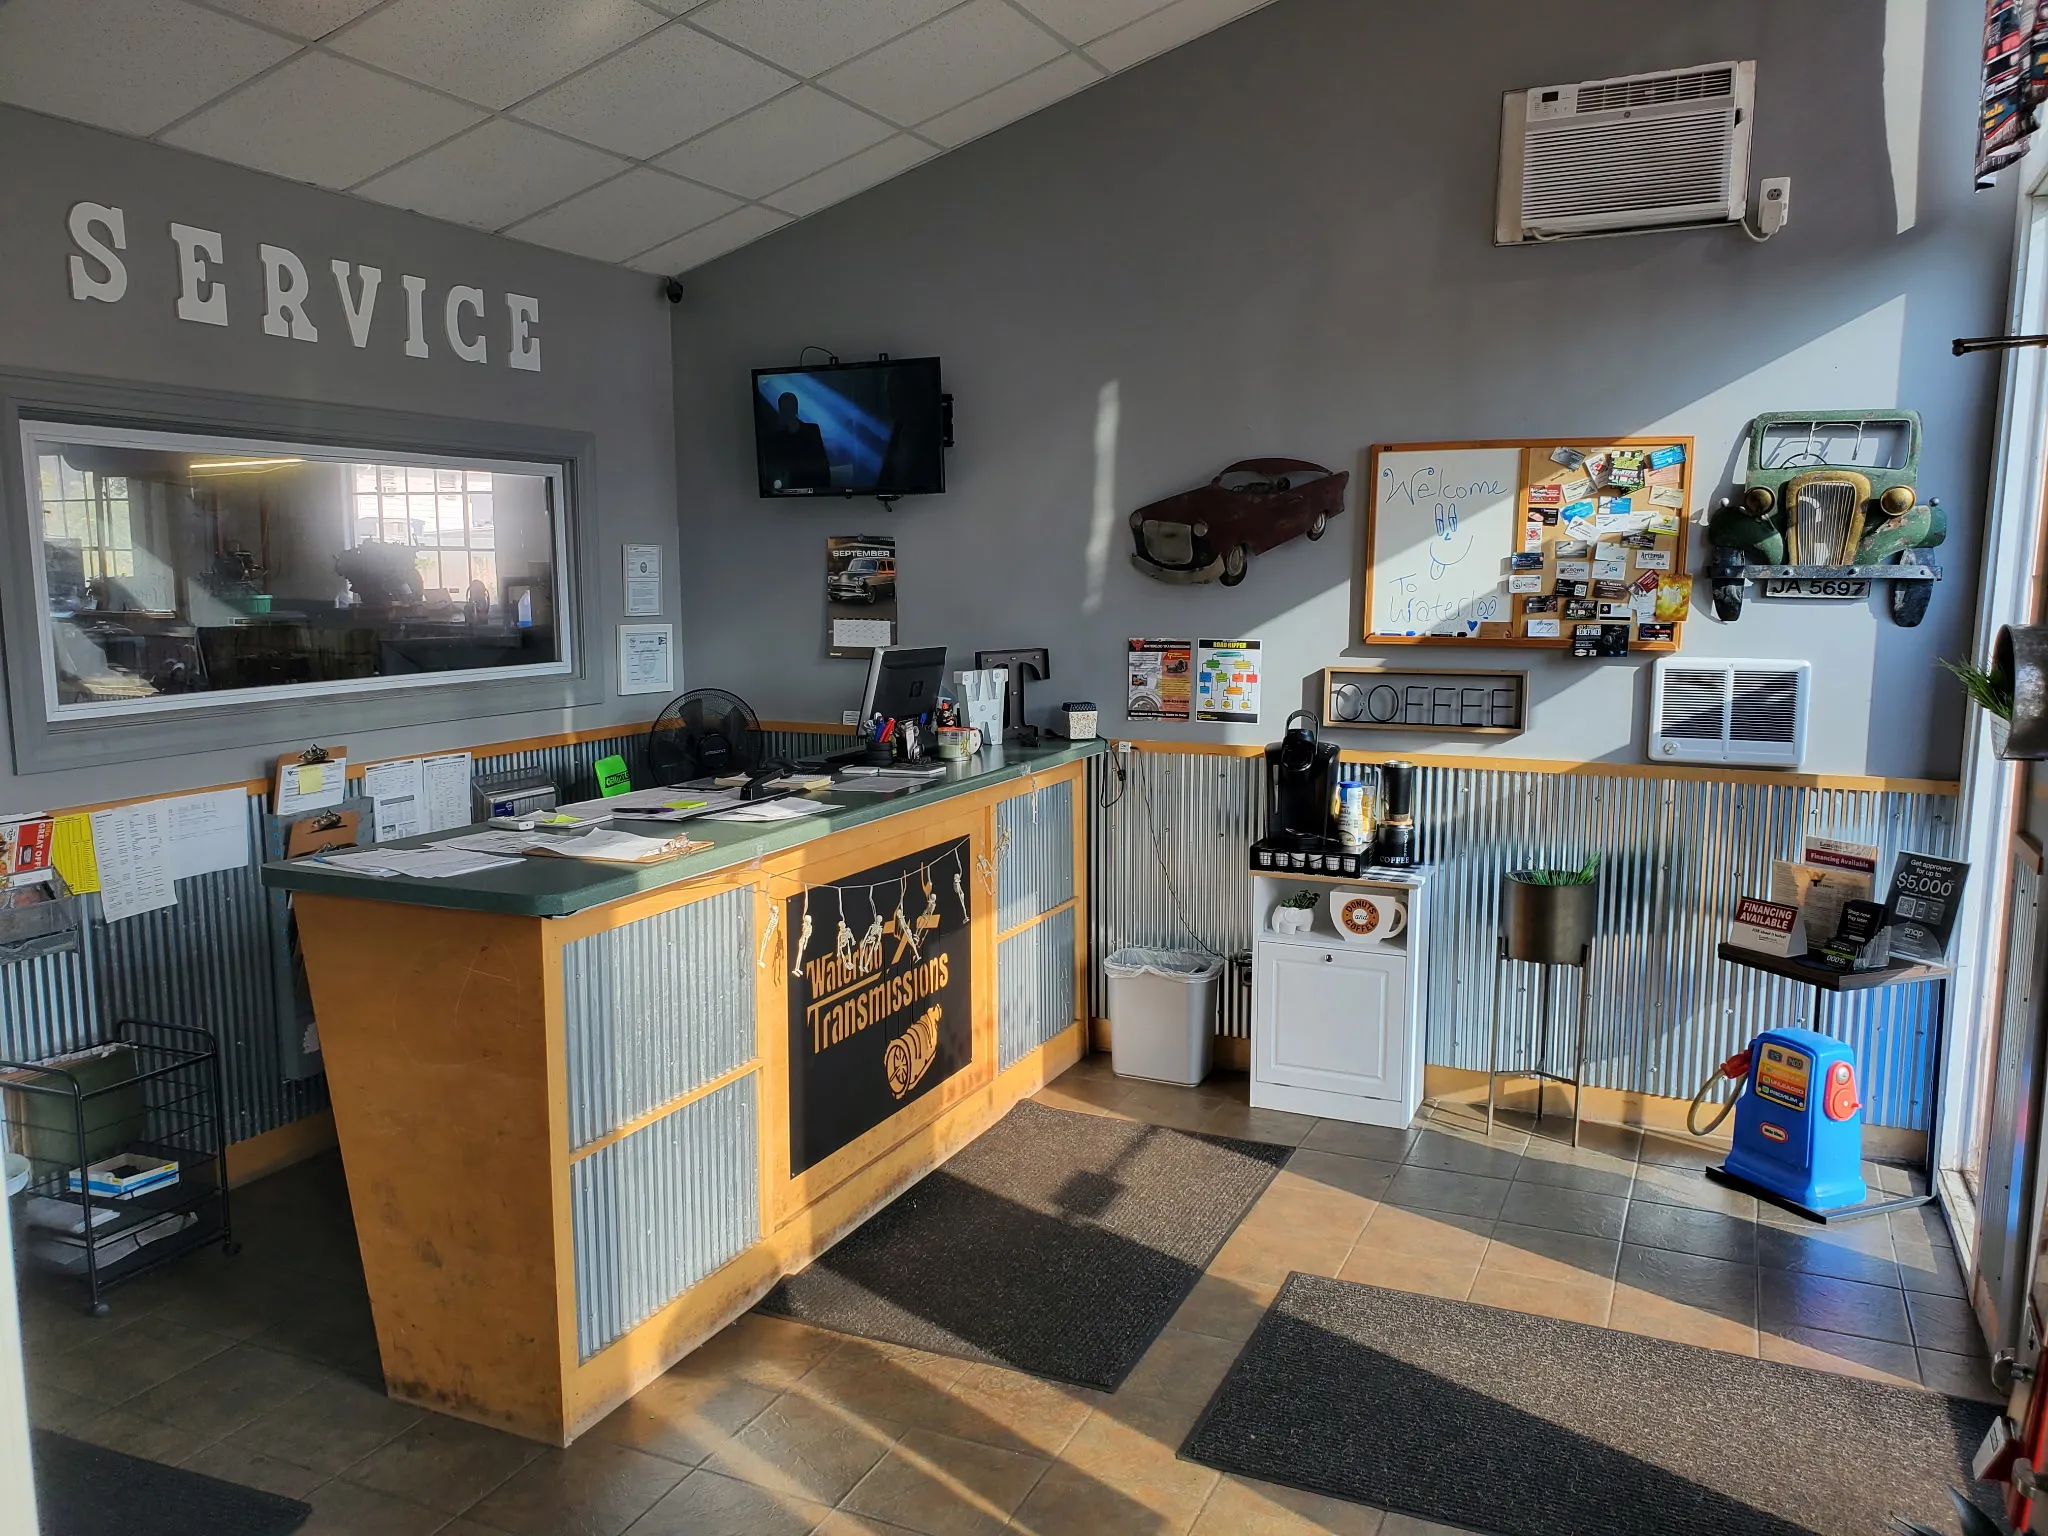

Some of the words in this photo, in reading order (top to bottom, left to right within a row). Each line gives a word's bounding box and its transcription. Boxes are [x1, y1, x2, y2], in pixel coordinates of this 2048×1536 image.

[66, 200, 542, 373] SERVICE
[1383, 467, 1508, 506] Welcome
[1389, 573, 1418, 594] To
[1772, 579, 1802, 594] JA
[1809, 580, 1866, 597] 5697
[1388, 590, 1498, 624] Waterloo
[1335, 683, 1515, 726] COFFEE
[36, 822, 45, 849] GREAT
[1379, 856, 1410, 864] COFFEE
[1810, 852, 1840, 865] Financing
[1840, 857, 1869, 869] Available
[1910, 859, 1922, 867] Get
[1922, 861, 1952, 873] approved
[1925, 870, 1934, 878] up
[1896, 871, 1953, 897] $5,000
[1345, 900, 1377, 915] DONUTS
[1354, 912, 1369, 921] and
[1743, 902, 1793, 920] FINANCING
[1345, 918, 1377, 932] COFFEE
[1739, 911, 1789, 930] AVAILABLE
[1847, 915, 1857, 923] Pay
[1857, 916, 1869, 924] later.
[807, 952, 950, 1055] Transmissions
[1770, 1077, 1804, 1095] UNLEADED
[1769, 1088, 1798, 1104] PREMIUM
